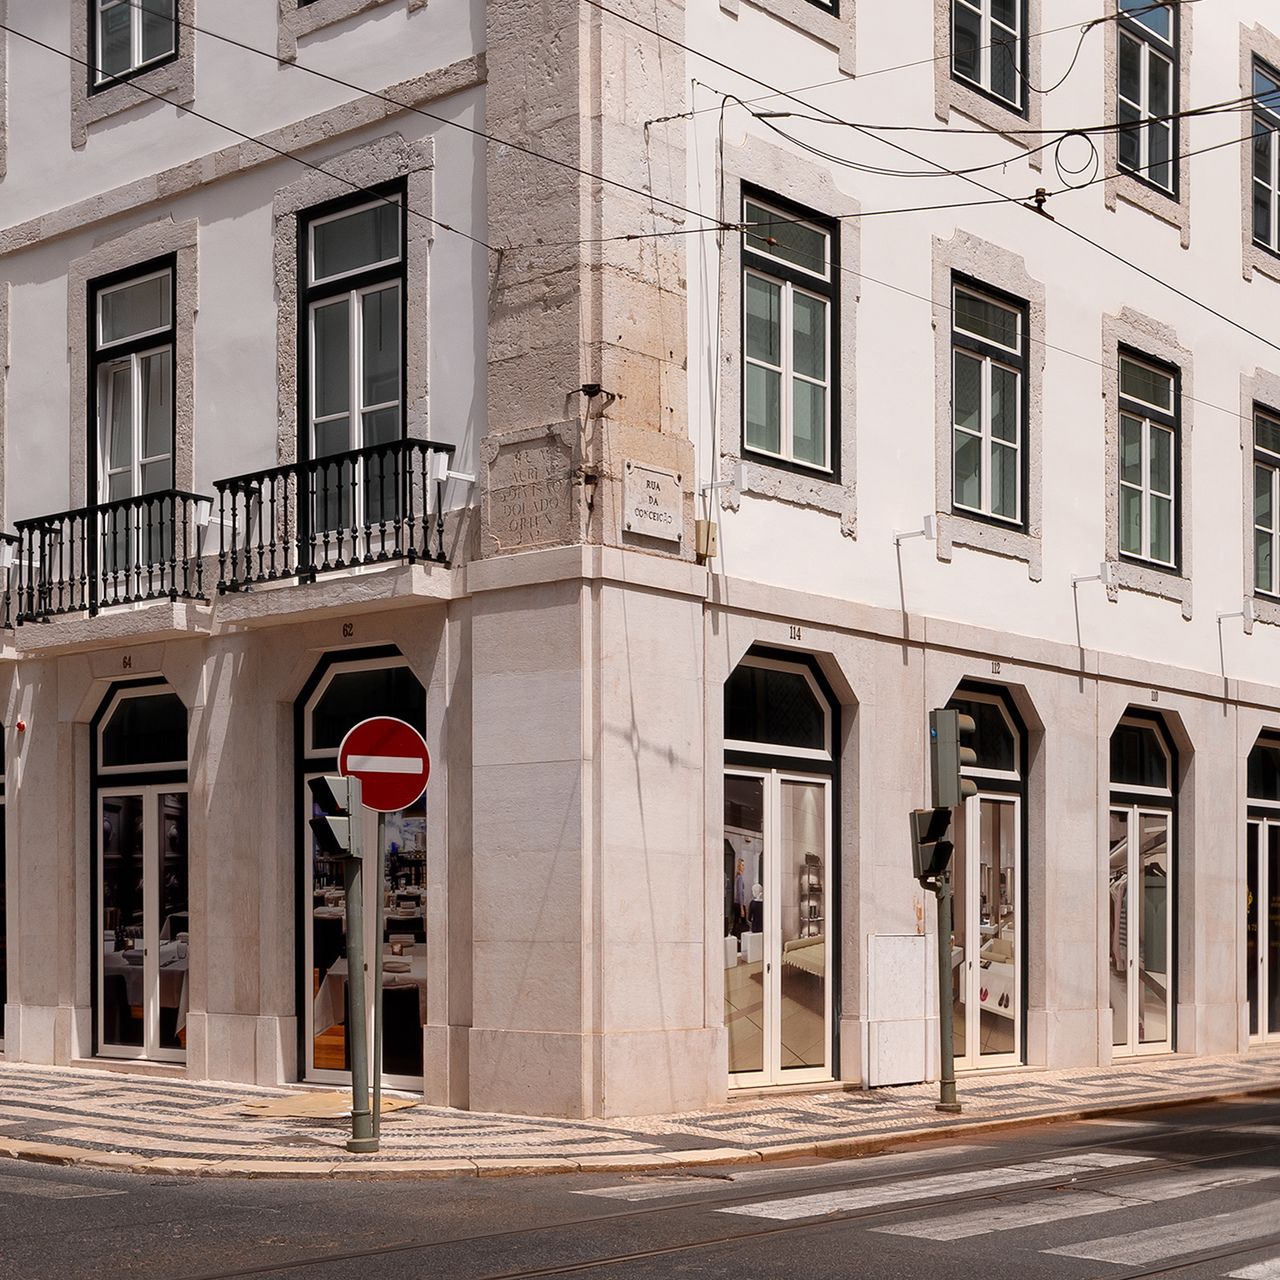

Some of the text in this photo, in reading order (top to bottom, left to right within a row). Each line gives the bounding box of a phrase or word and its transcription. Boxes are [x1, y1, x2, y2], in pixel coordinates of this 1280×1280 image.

[646, 480, 661, 491] RUA
[648, 495, 659, 507] DA
[342, 622, 354, 638] 62
[789, 625, 801, 641] 114
[122, 655, 132, 669] 64
[991, 662, 1001, 675] 112
